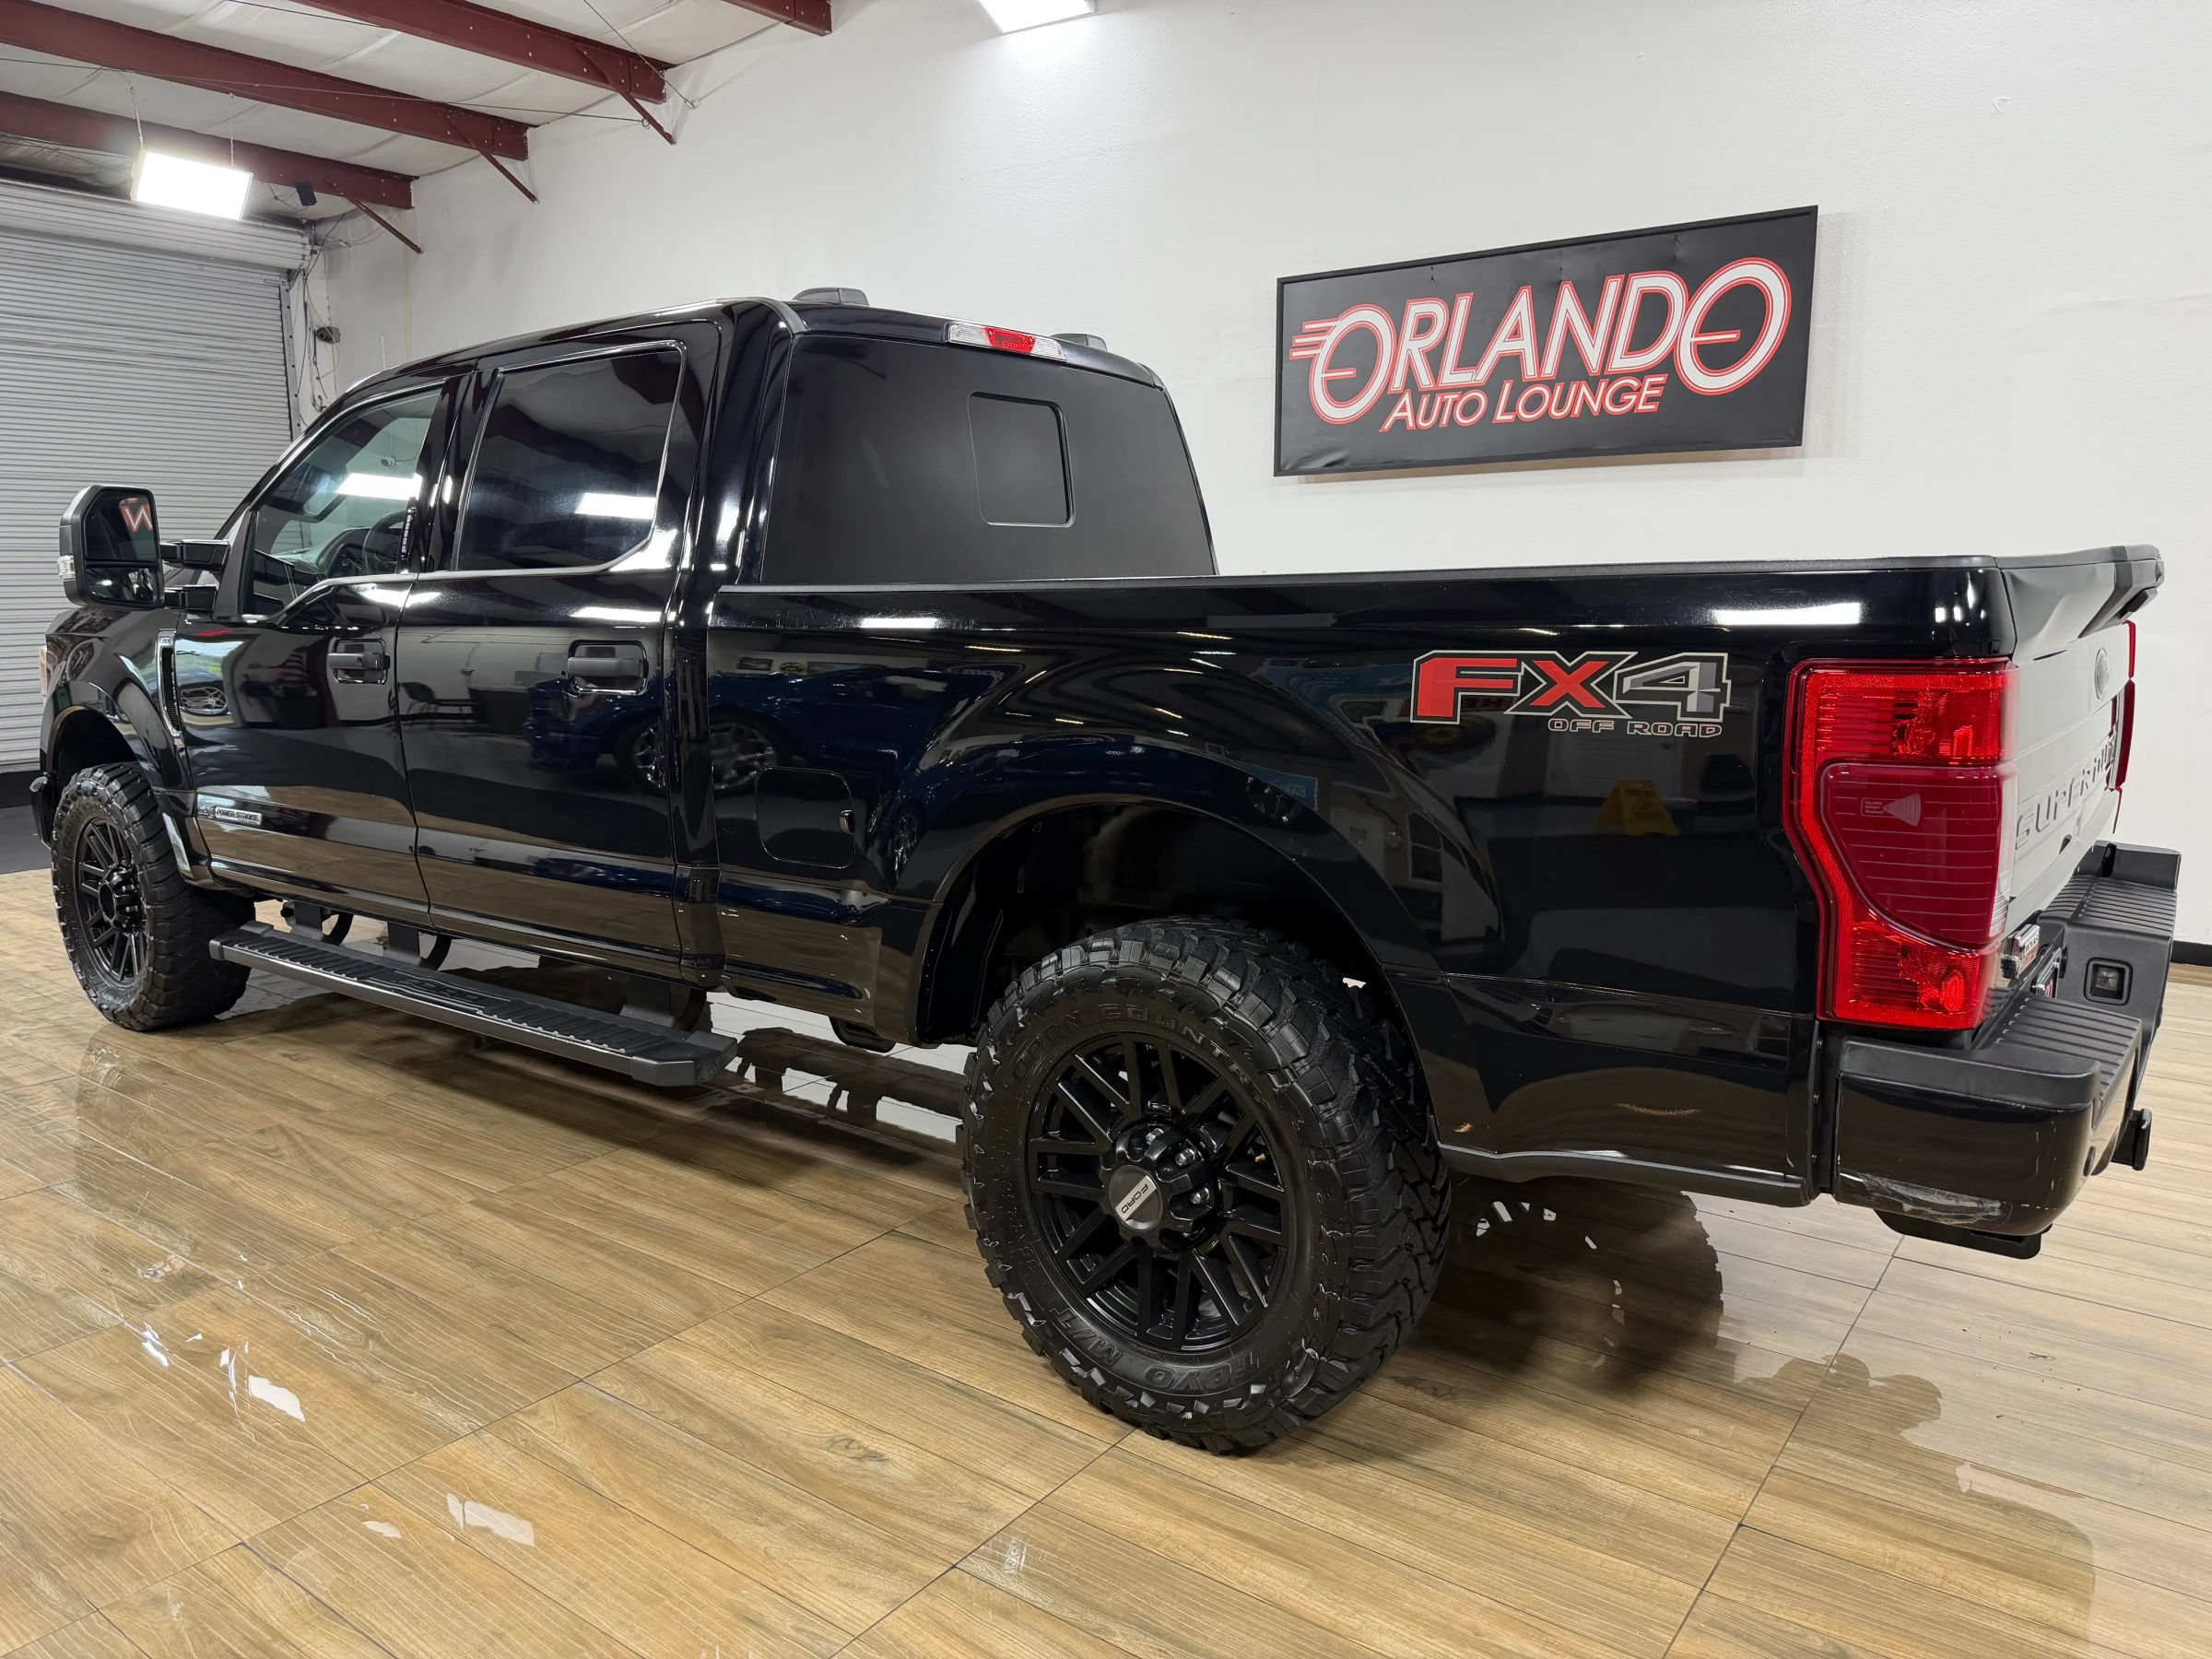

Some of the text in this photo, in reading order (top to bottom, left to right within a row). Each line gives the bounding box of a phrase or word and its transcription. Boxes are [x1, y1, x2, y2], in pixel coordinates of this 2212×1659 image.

[1308, 257, 1792, 426] ORLANDO
[1379, 374, 1667, 431] AUTO LOUNGE
[1410, 650, 1731, 724] FX4
[1547, 718, 1724, 738] OFF ROAD
[1121, 1183, 1149, 1214] FORD
